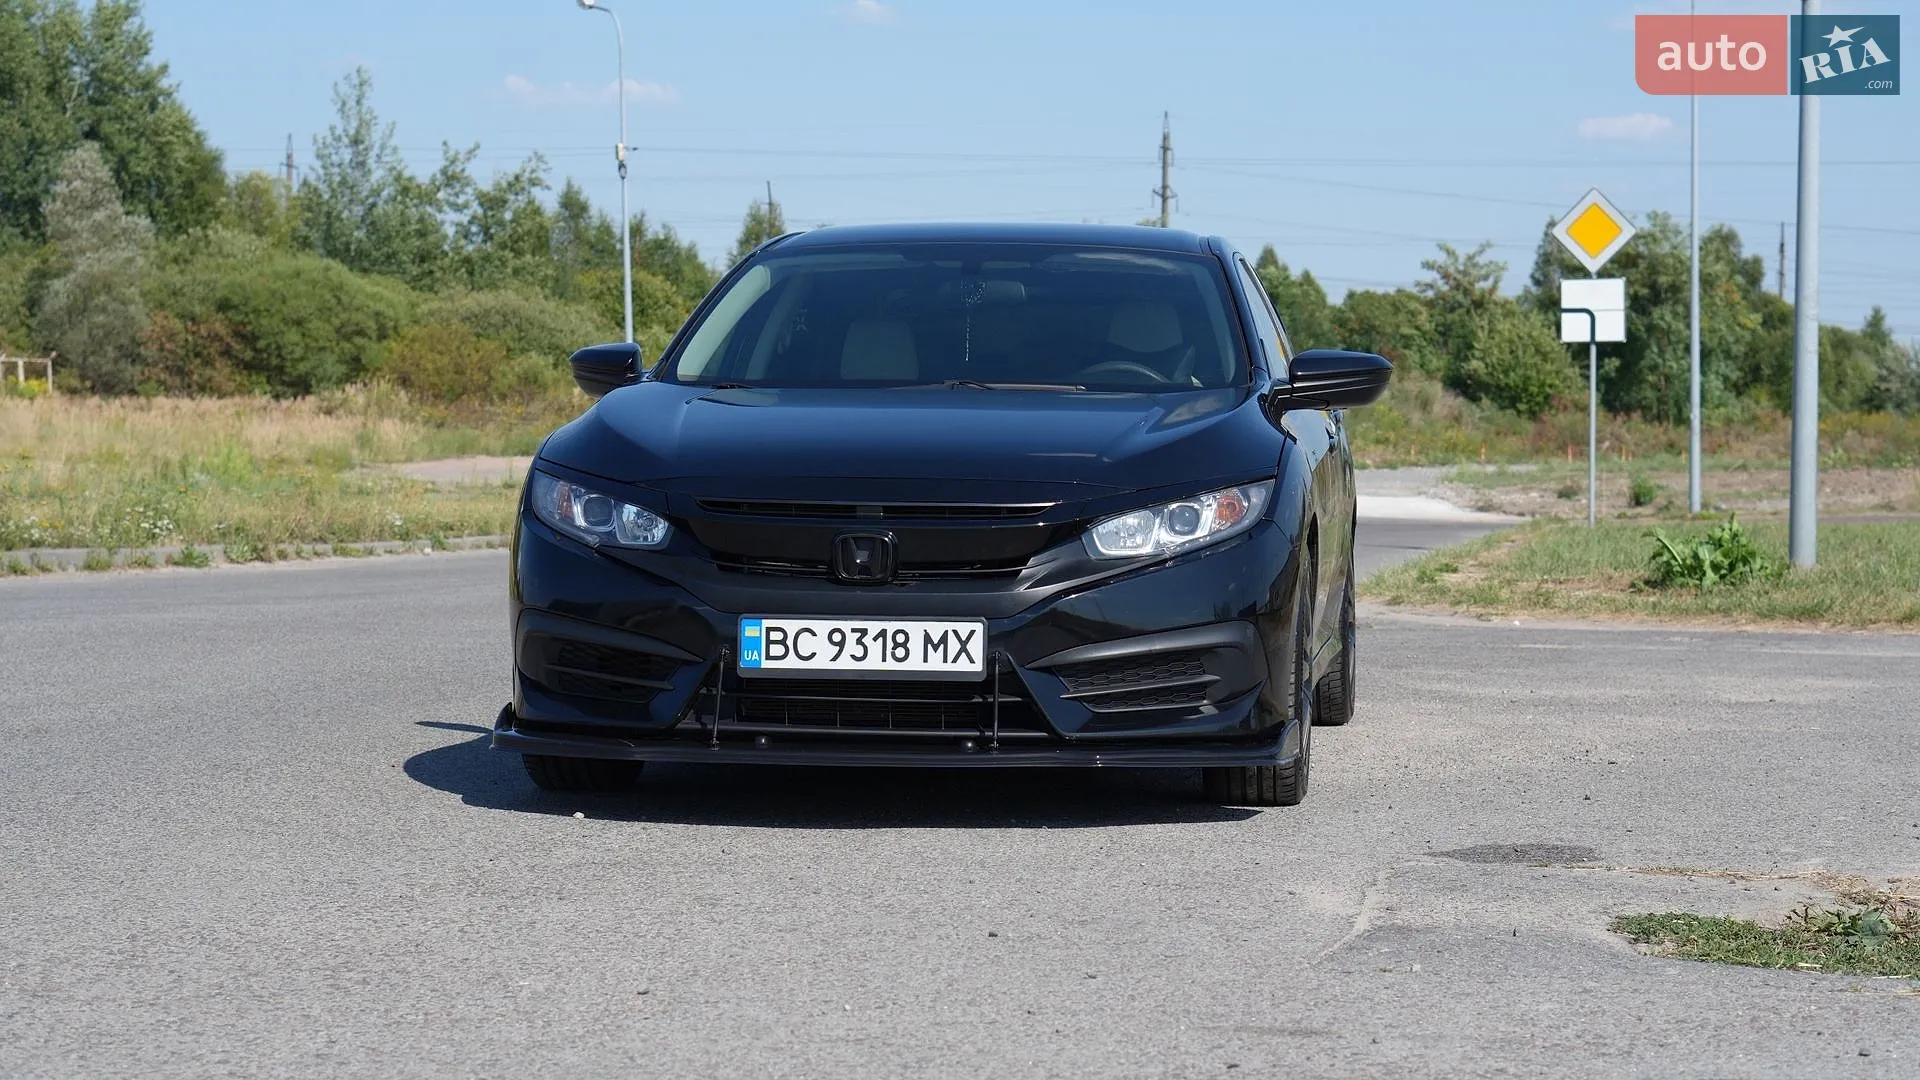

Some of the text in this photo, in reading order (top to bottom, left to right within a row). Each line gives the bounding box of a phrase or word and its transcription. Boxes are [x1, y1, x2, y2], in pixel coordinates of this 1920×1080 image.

[744, 650, 760, 661] UA
[764, 626, 977, 664] BC 9318 MX
